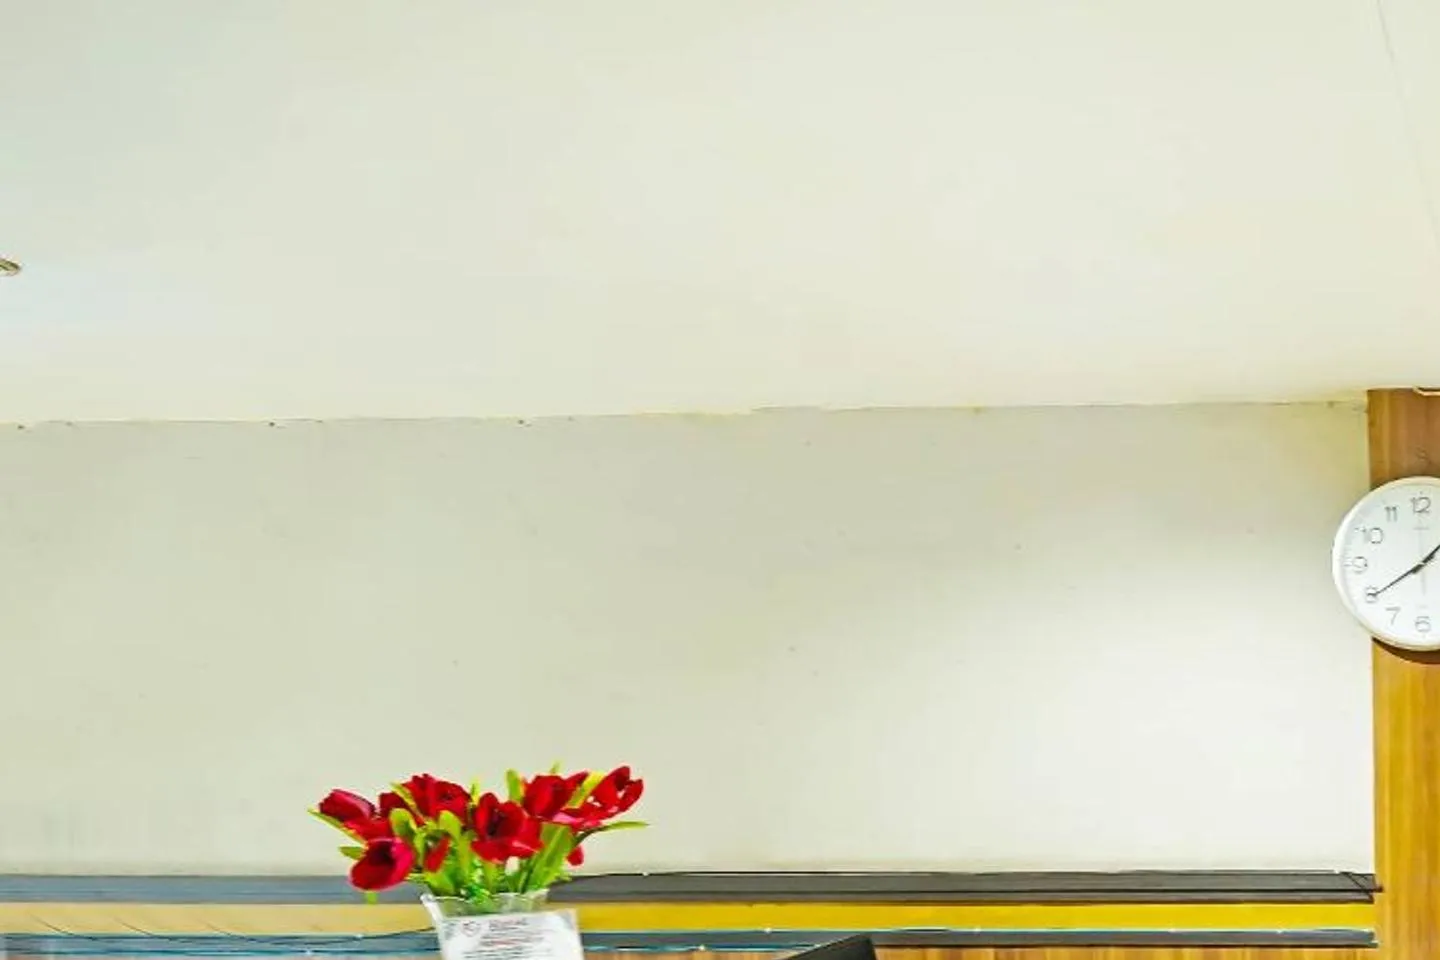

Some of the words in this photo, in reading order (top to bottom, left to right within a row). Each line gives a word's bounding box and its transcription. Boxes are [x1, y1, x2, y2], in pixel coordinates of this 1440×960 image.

[1384, 506, 1398, 522] 11
[1410, 496, 1431, 514] 12
[1365, 586, 1379, 604] 8
[1386, 606, 1401, 625] 7
[1415, 616, 1432, 633] 6
